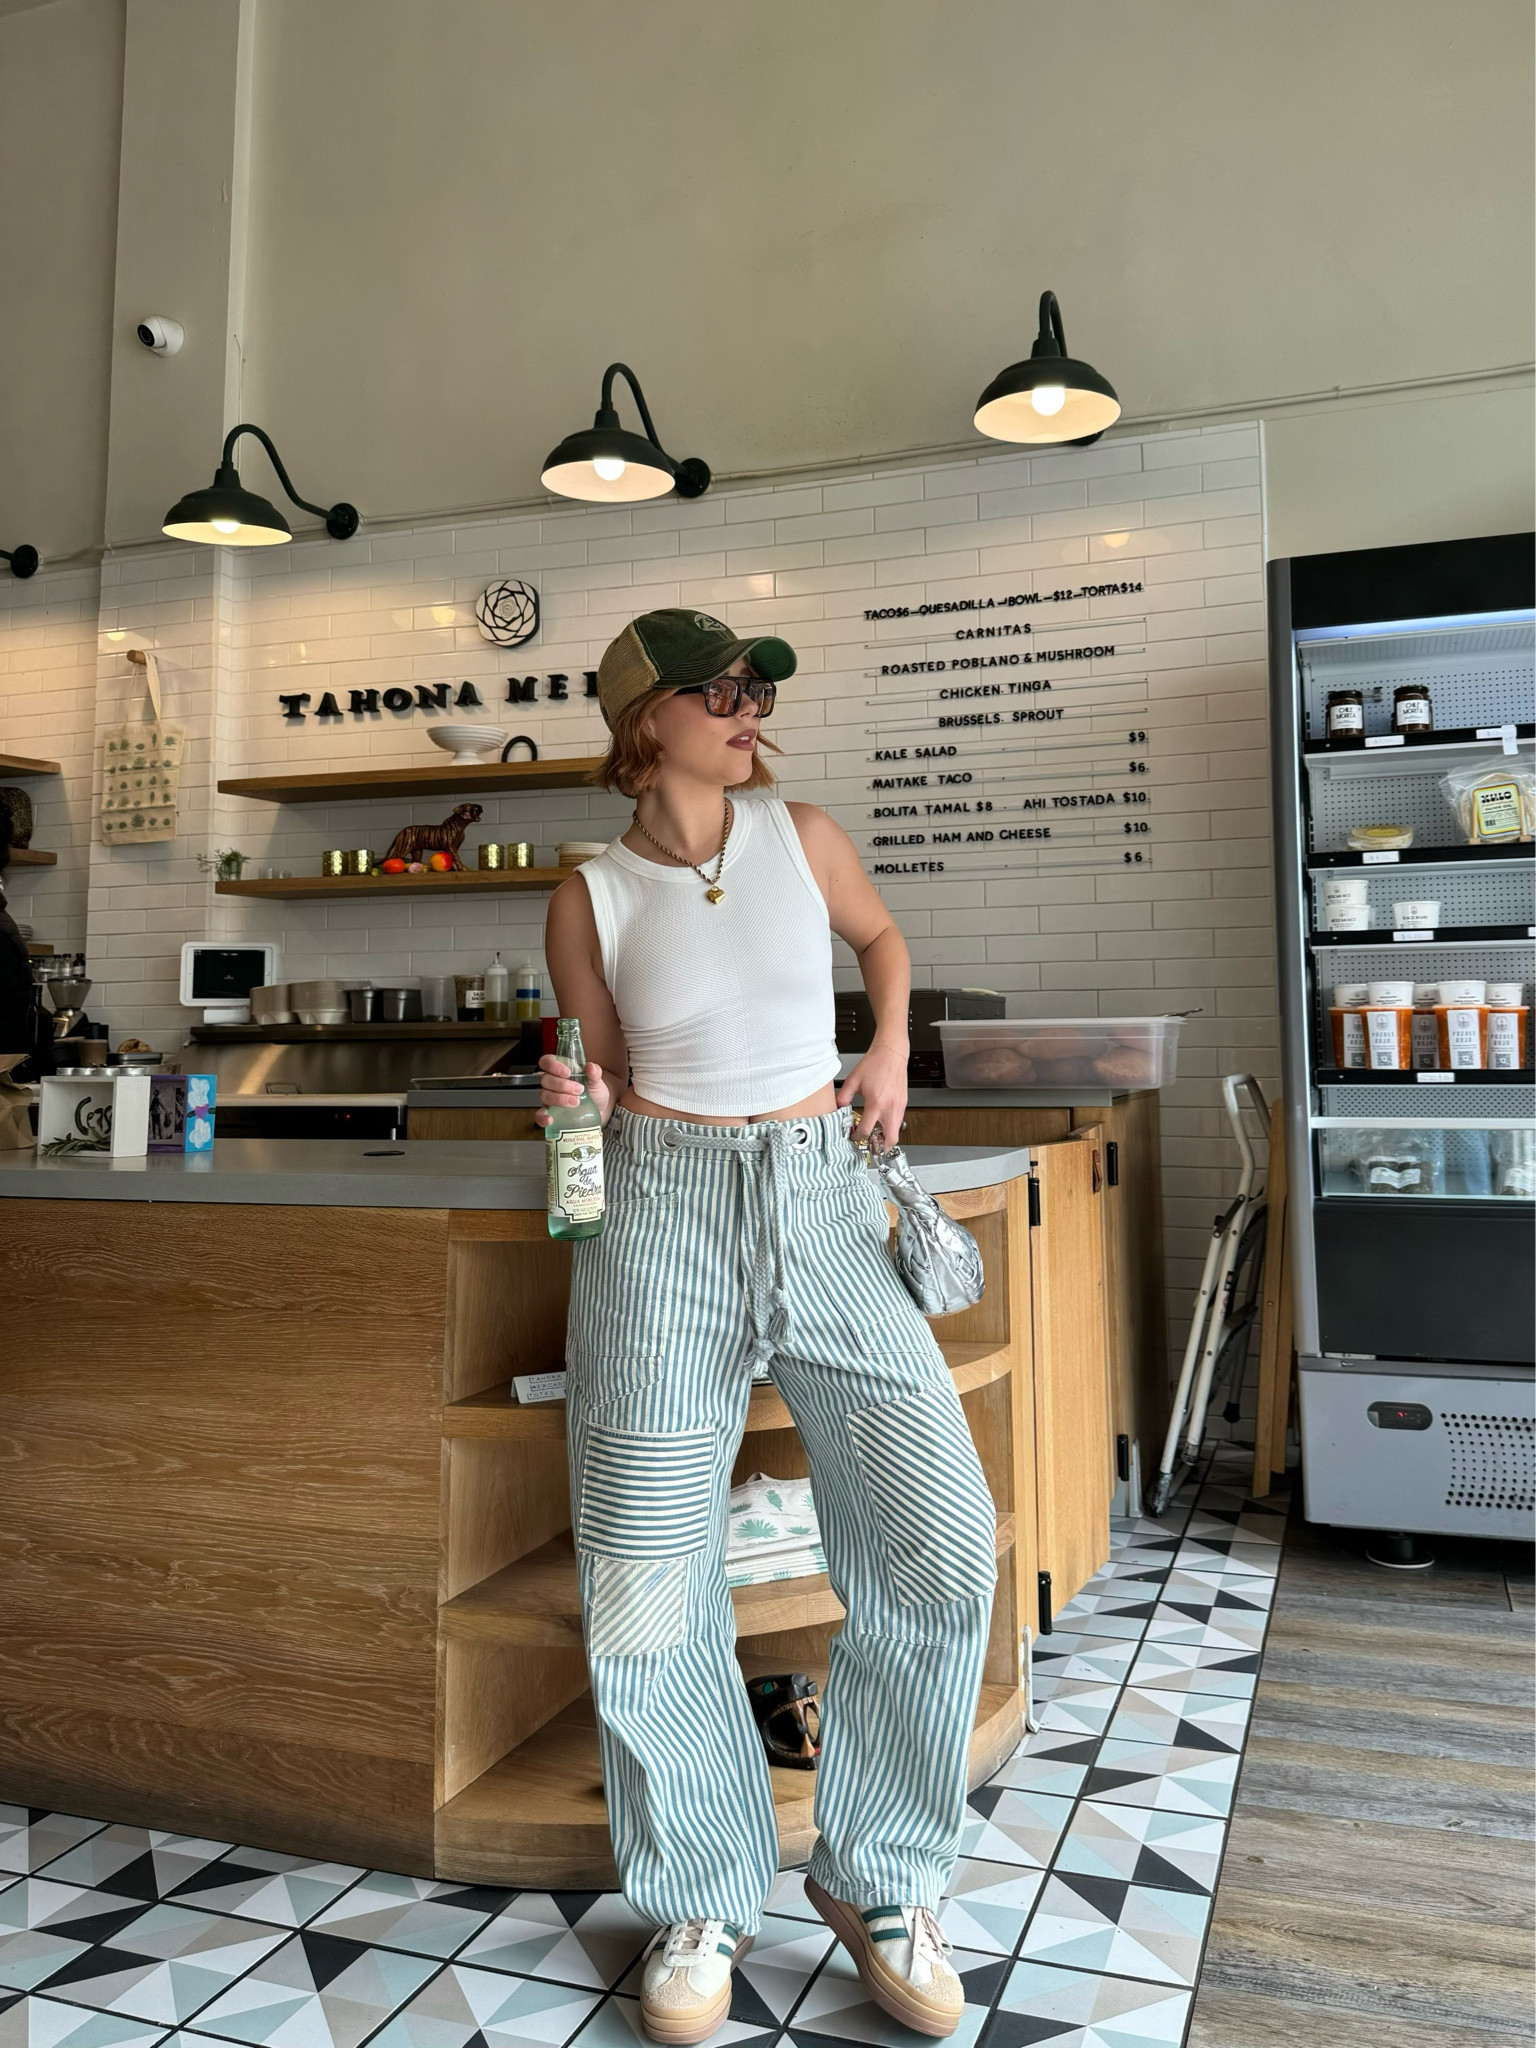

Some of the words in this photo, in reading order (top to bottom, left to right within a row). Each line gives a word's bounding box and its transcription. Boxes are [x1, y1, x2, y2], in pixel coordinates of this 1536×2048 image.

[956, 623, 1031, 640] CARNITAS
[882, 661, 945, 675] ROASTED
[952, 654, 1019, 669] POBLANO
[1024, 653, 1032, 663] &
[1037, 645, 1115, 661] MUSHROOM
[1008, 680, 1052, 693] TINGA
[279, 680, 483, 718] TAHONA
[1013, 708, 1064, 722] SPROUT
[875, 749, 907, 761] KALE
[915, 746, 957, 758] SALAD
[1129, 731, 1146, 743] $9
[873, 776, 928, 789] MAITAKE
[938, 772, 972, 784] TACO
[1129, 761, 1146, 773] $6
[874, 806, 918, 818] BOLITA
[925, 802, 970, 815] TAMAL
[976, 801, 993, 812] $8
[1023, 798, 1046, 810] AHI
[1052, 793, 1115, 807] TOSTADA
[1123, 791, 1146, 803] $10
[873, 834, 925, 846] GRILLED
[933, 832, 961, 843] HAM
[966, 831, 994, 842] AND
[999, 827, 1052, 840] CHEESE
[1123, 822, 1148, 834] $10
[874, 862, 944, 874] MOLLETES
[567, 1163, 598, 1182] Agua
[583, 1176, 592, 1185] de
